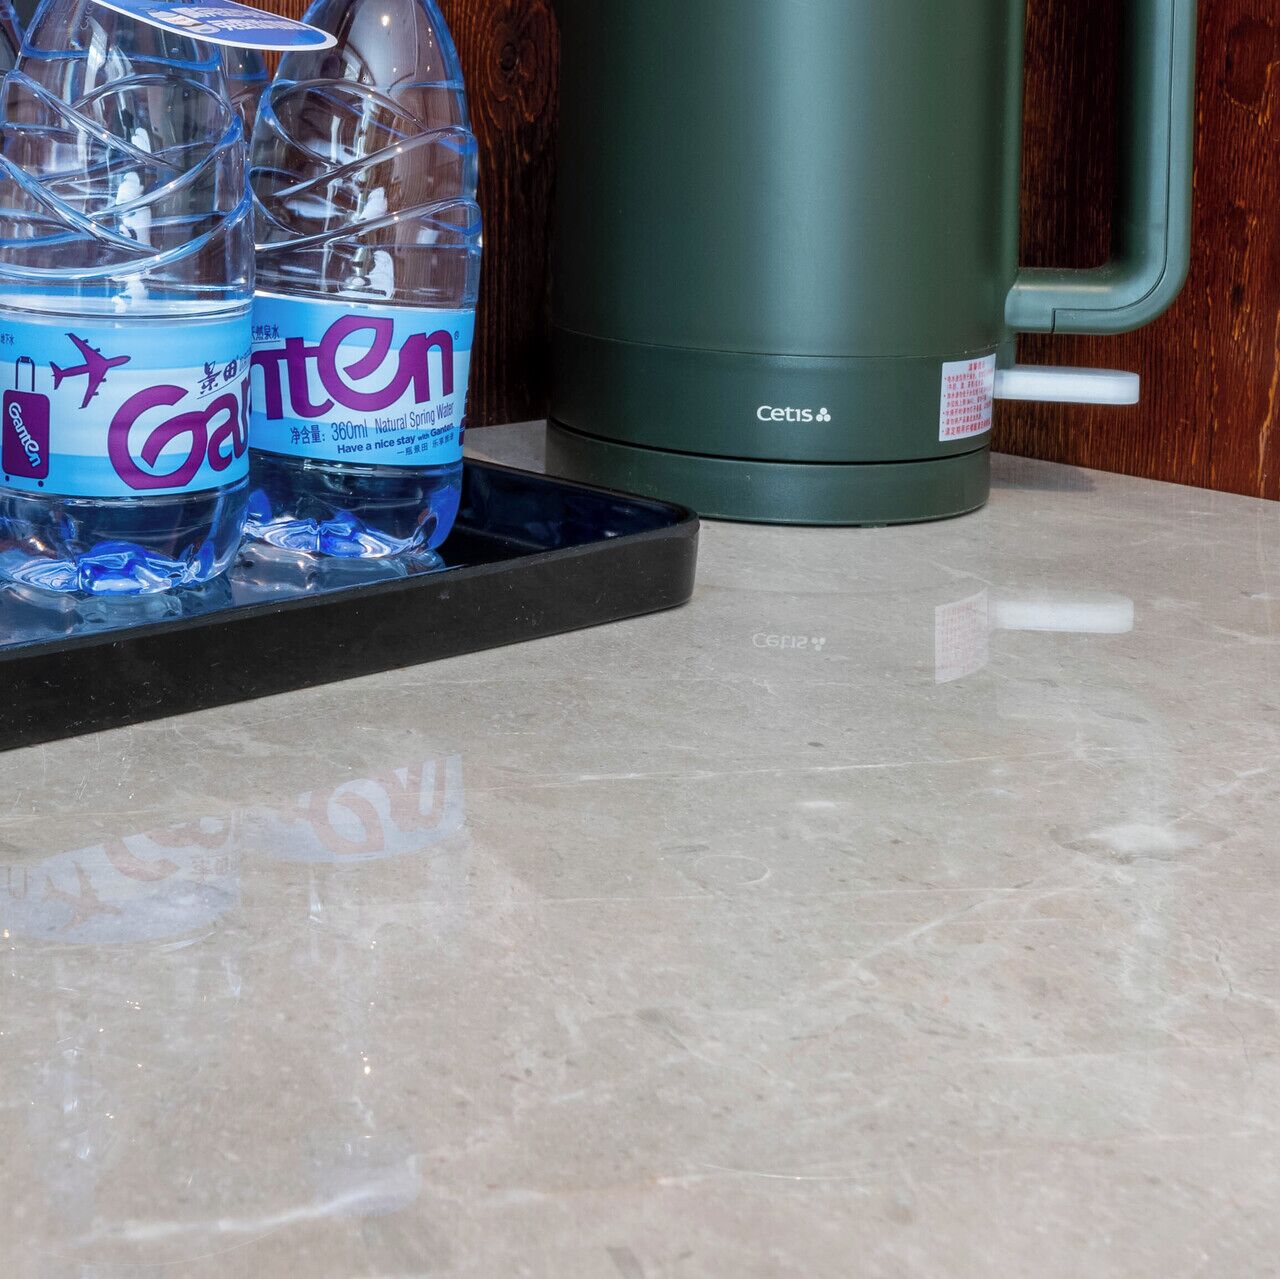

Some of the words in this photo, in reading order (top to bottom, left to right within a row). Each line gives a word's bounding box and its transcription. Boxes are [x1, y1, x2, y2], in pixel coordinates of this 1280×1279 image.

[197, 359, 238, 395] 景田
[375, 417, 407, 435] Natural
[410, 410, 435, 430] Spring
[436, 402, 454, 420] Water
[756, 405, 813, 422] Cetis
[8, 401, 41, 467] Ganten
[331, 420, 368, 442] 360ml
[337, 443, 364, 455] Have
[366, 442, 372, 451] a
[375, 439, 395, 450] nice
[397, 434, 416, 448] stay
[417, 432, 430, 441] with
